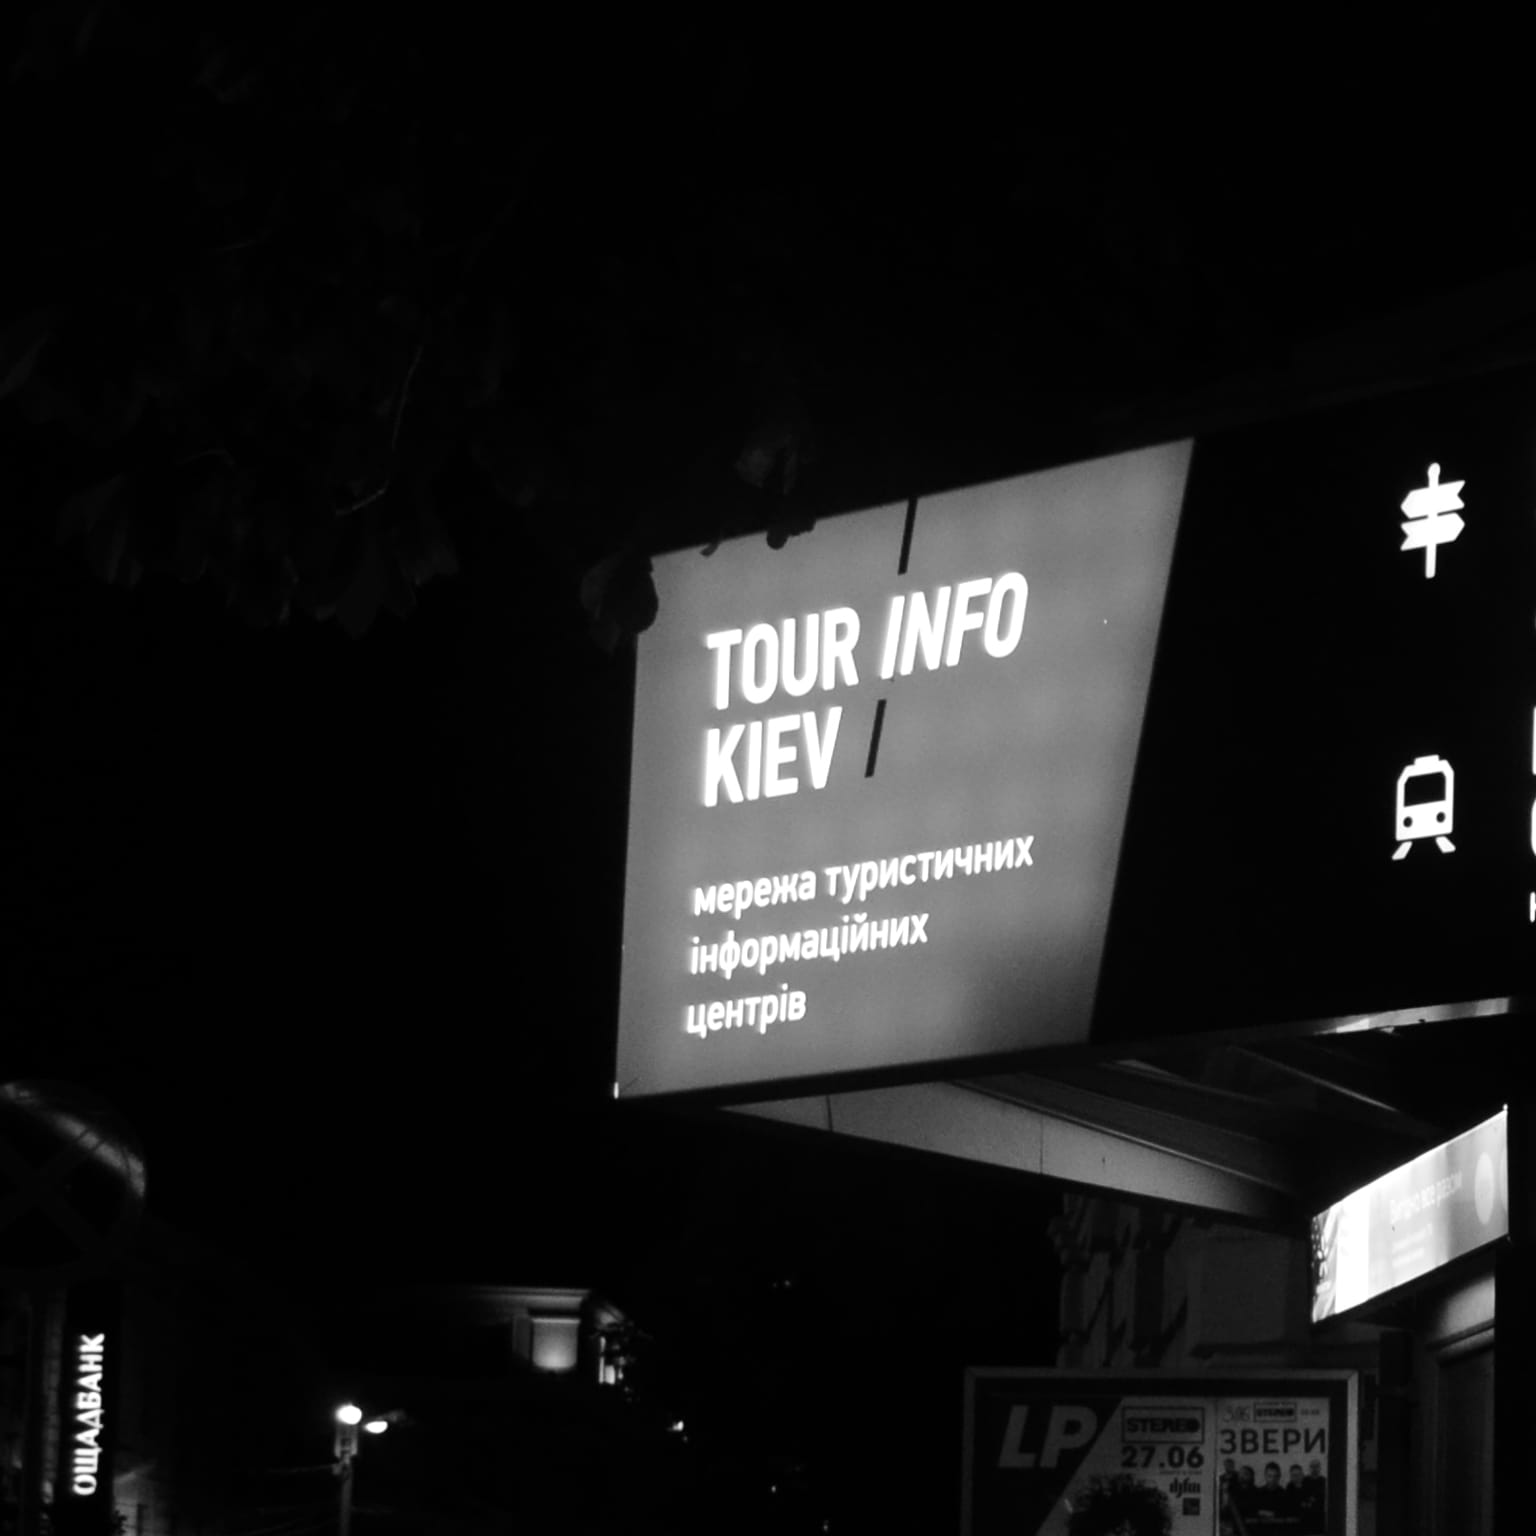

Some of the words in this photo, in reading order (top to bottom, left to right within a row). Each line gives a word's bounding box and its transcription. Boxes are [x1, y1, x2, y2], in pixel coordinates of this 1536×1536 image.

[705, 606, 860, 711] TOUR
[879, 571, 1029, 680] INFO
[703, 706, 842, 808] KIEV
[693, 867, 816, 920] мережа
[825, 835, 1034, 904] туристичних
[690, 911, 929, 980] інформаційних
[686, 983, 808, 1040] центрів
[71, 1331, 107, 1498] ОЩАДБАНК
[997, 1404, 1098, 1469] LP
[1220, 1427, 1326, 1456] ЗВЕРИ
[1120, 1445, 1205, 1470] 27.06
